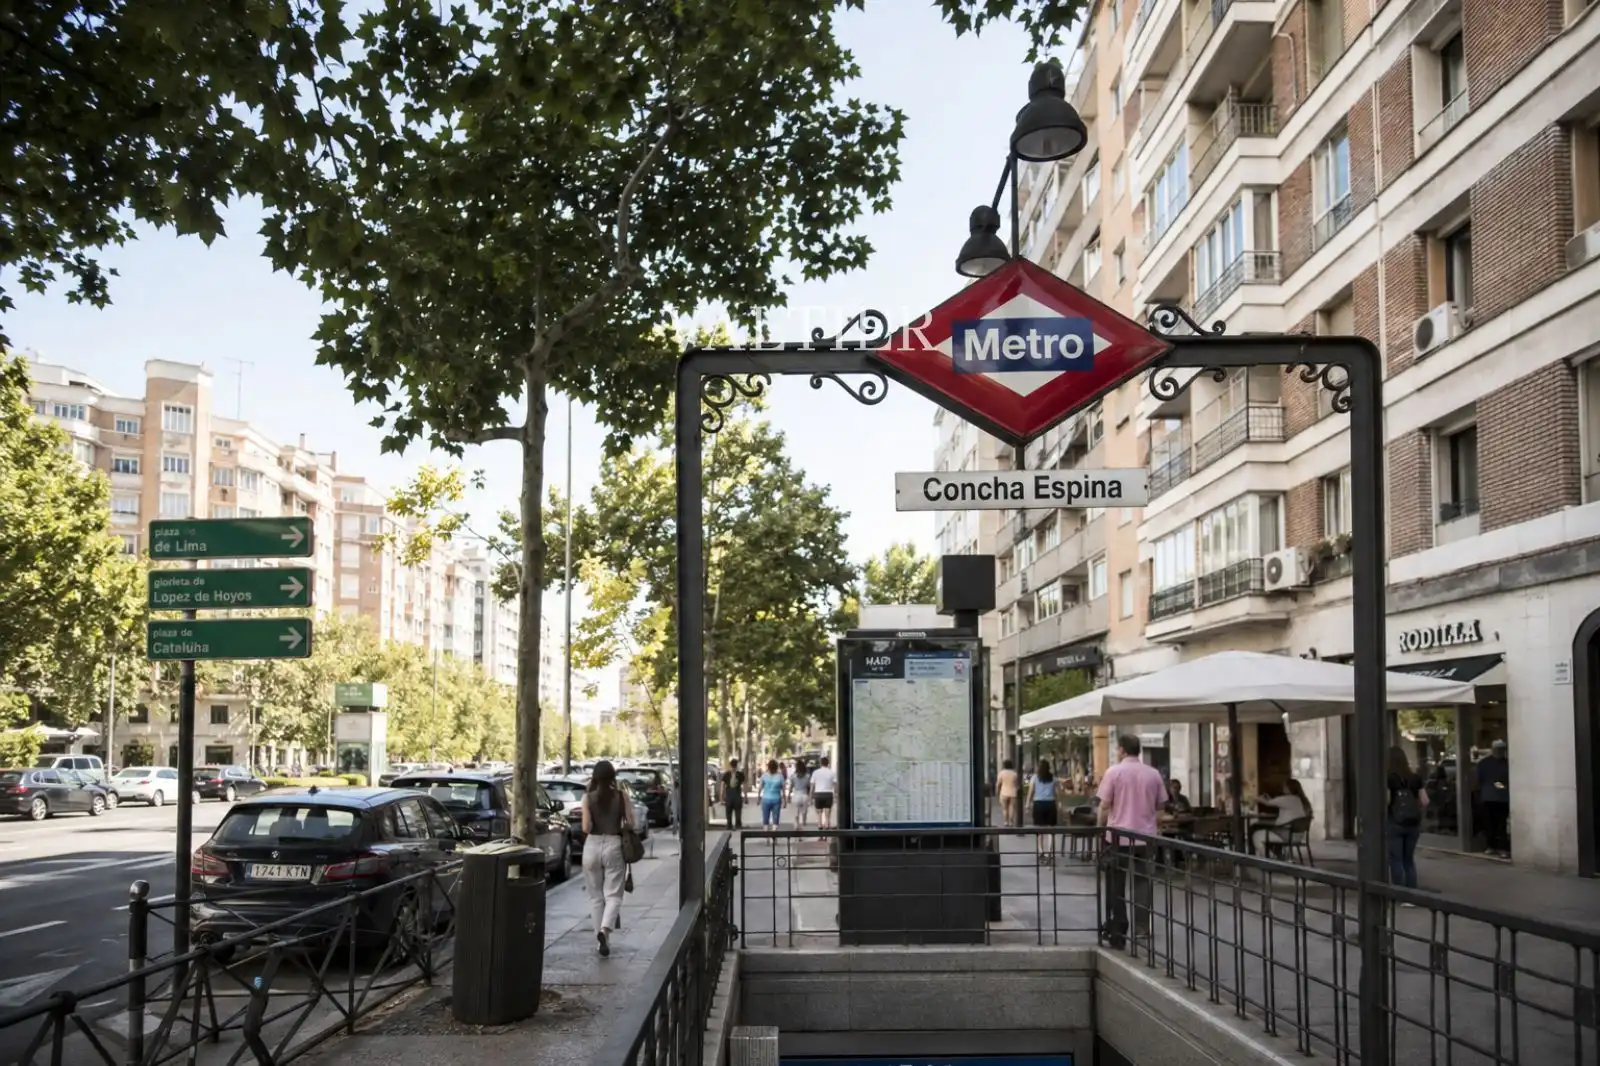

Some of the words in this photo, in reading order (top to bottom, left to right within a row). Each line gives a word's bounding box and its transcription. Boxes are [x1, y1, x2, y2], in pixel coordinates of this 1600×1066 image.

[965, 328, 1084, 361] Metro
[923, 476, 1024, 502] Concha
[1034, 475, 1122, 504] Espina
[155, 528, 180, 538] plaza
[154, 542, 171, 553] de
[176, 540, 207, 552] Lima
[154, 577, 191, 589] glorieta
[193, 577, 205, 586] de
[154, 591, 190, 604] Lopez
[195, 591, 210, 602] de
[214, 590, 252, 604] Hoyos
[153, 628, 178, 639] plaza
[180, 628, 193, 637] de
[1398, 620, 1483, 653] RODILLA
[255, 865, 281, 876] 1741
